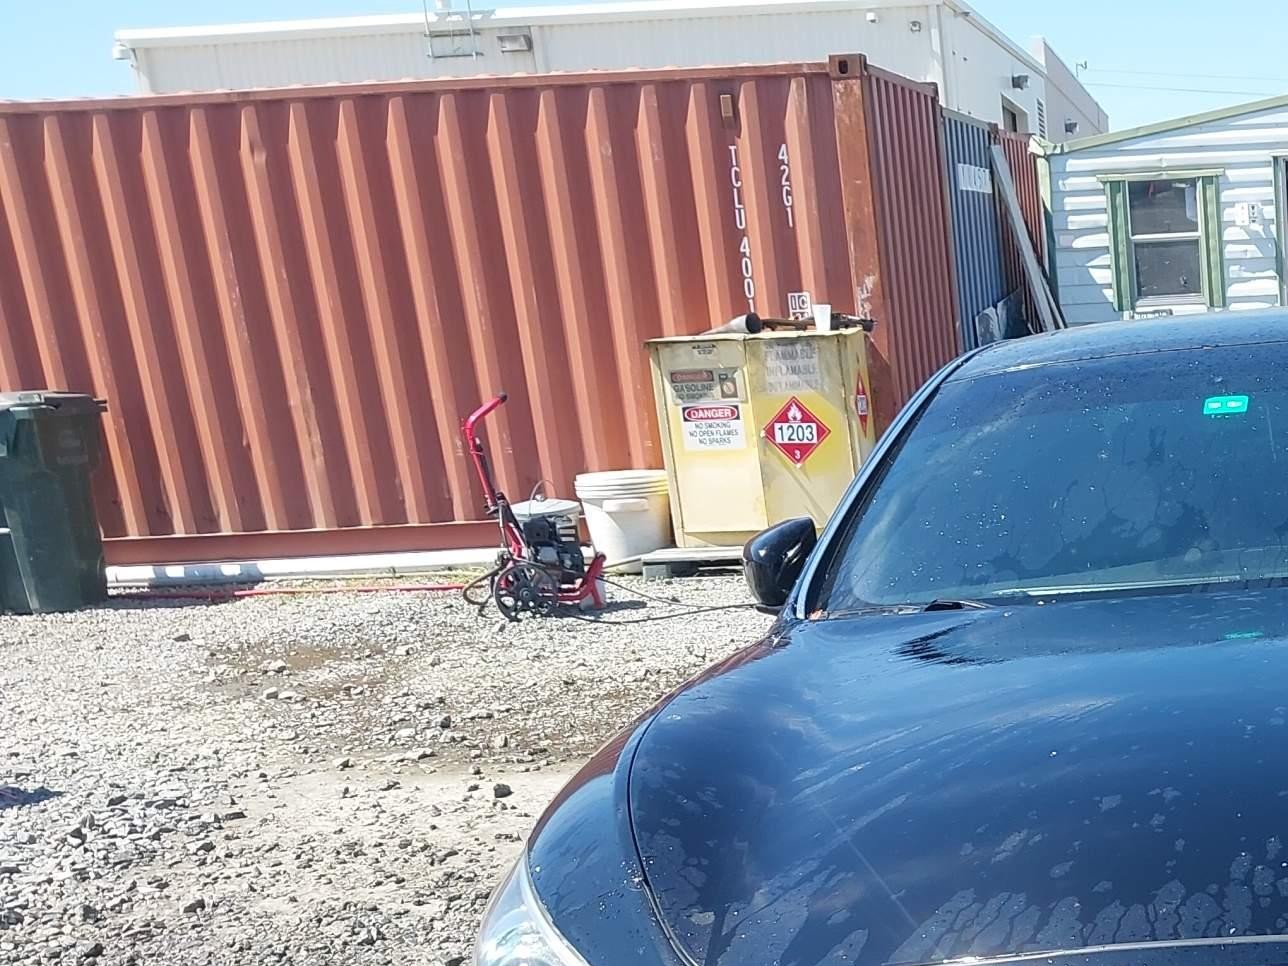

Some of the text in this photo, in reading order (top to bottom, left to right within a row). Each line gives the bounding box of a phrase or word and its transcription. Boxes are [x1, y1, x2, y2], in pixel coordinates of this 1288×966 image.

[728, 145, 746, 230] TCLU
[778, 143, 793, 228] 42G1
[673, 383, 715, 393] GASOLINE
[690, 408, 731, 419] DANGER
[716, 429, 739, 437] FLAMES
[778, 424, 814, 441] 1203
[709, 437, 731, 445] SPARKS
[795, 450, 801, 460] 3
